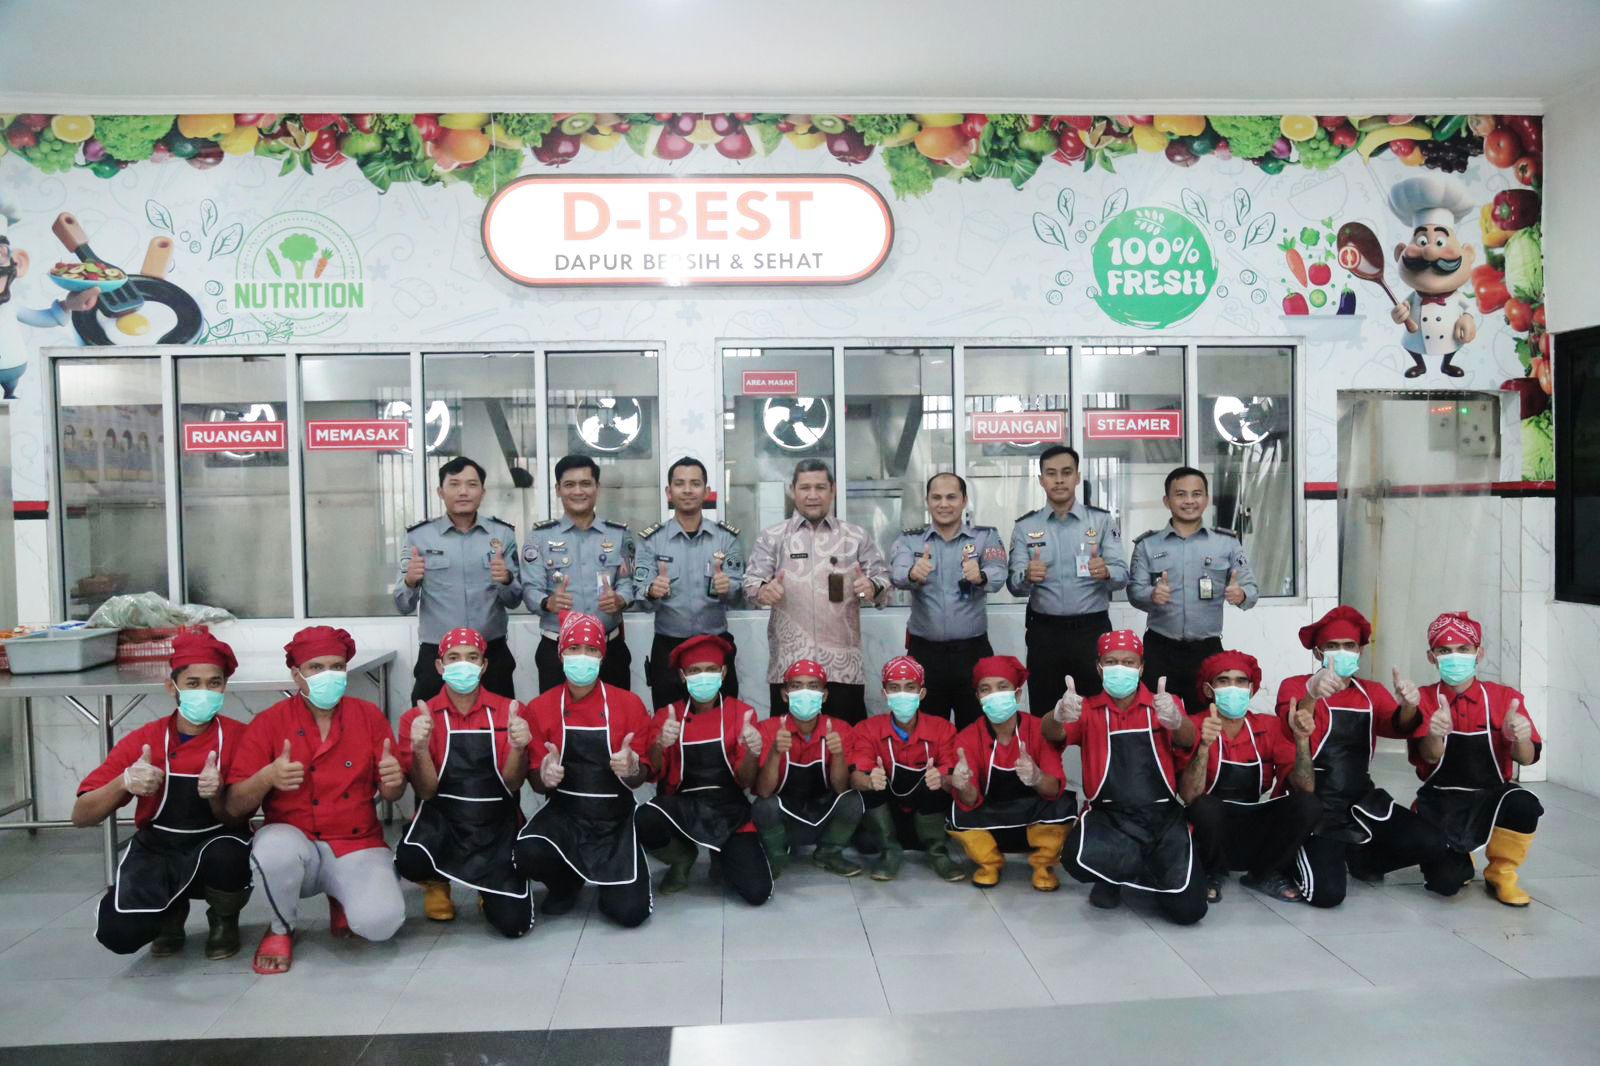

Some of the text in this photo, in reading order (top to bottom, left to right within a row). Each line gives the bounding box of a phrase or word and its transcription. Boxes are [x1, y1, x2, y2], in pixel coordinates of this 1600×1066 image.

[563, 190, 814, 241] D-BEST
[555, 253, 633, 271] DAPUR
[729, 253, 744, 270] &
[753, 252, 824, 270] SEHAT
[1107, 235, 1200, 266] 100%
[234, 282, 364, 309] NUTRITION
[1106, 269, 1207, 296] FRESH
[192, 428, 400, 444] RUANGAN MEMASAK
[976, 418, 1171, 435] RUANGAN STEAMER
